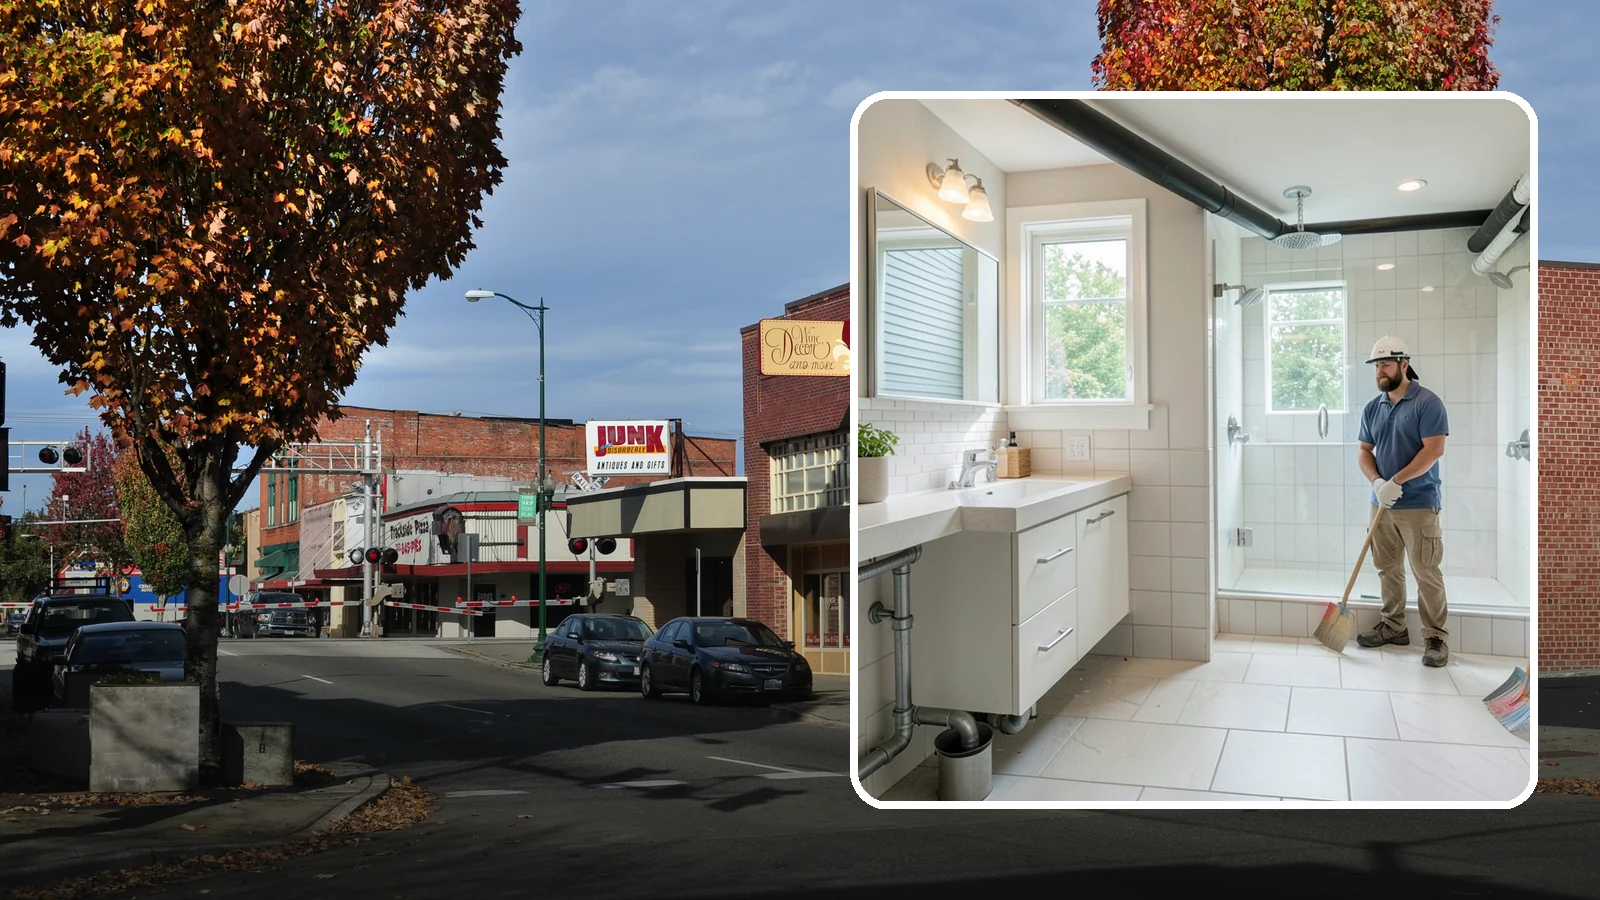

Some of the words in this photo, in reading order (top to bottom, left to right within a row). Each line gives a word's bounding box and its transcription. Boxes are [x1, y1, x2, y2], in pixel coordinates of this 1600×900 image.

[765, 327, 831, 365] Decor
[595, 425, 667, 458] JUNK
[607, 447, 646, 455] DISORDERLY
[596, 461, 628, 470] ANTIQUES
[631, 461, 644, 470] AND
[647, 460, 665, 470] GIFTS
[573, 473, 589, 492] RAIL
